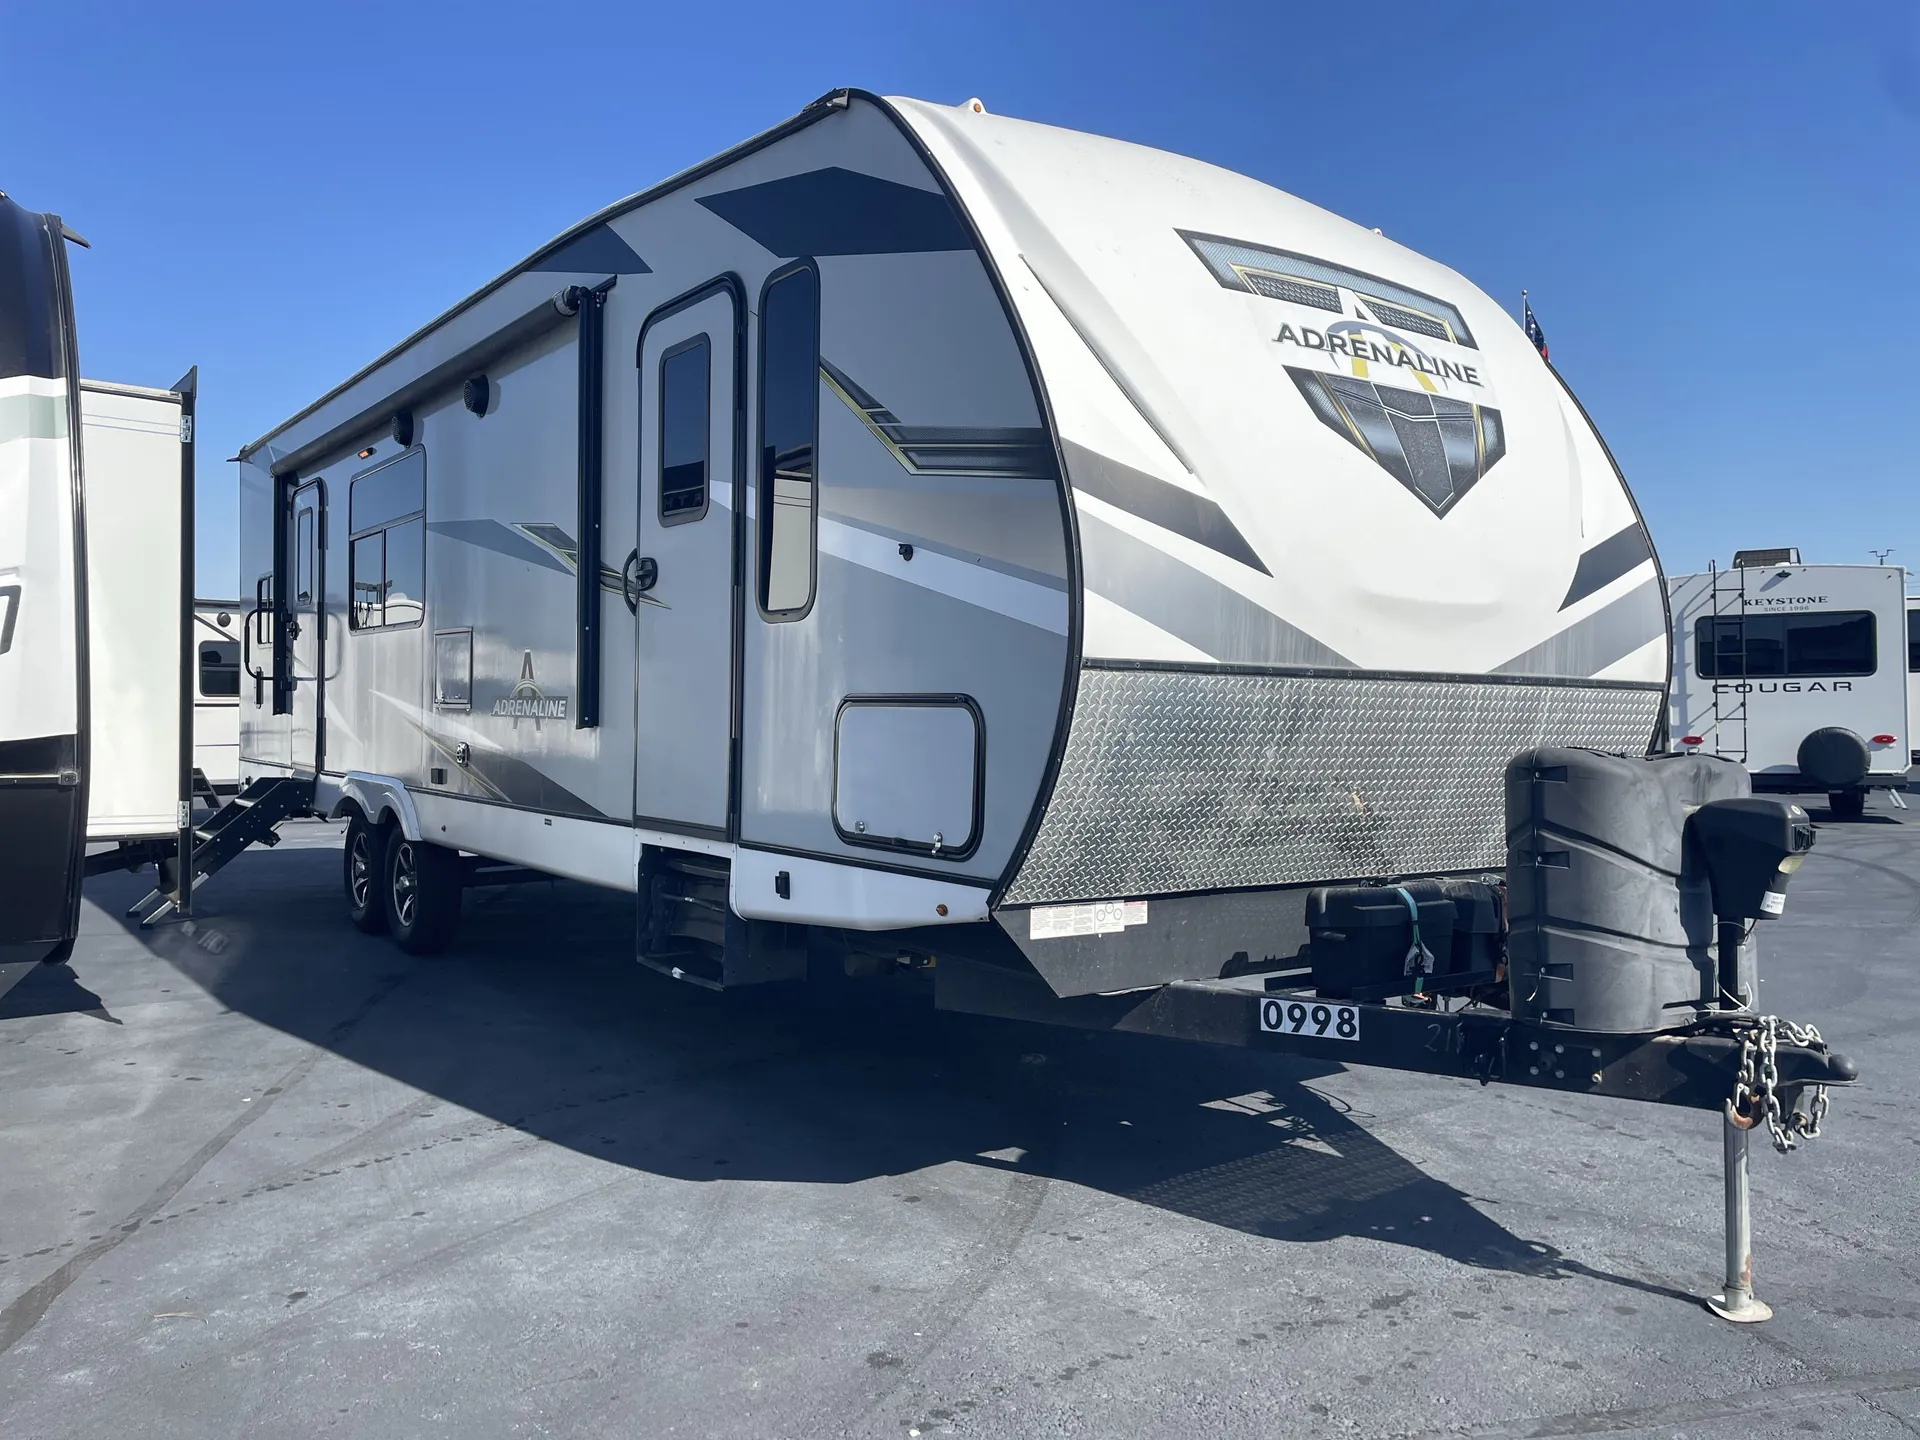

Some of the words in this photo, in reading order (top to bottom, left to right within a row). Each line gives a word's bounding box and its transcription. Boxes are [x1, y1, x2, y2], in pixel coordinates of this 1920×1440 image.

[1272, 322, 1485, 388] ADRENALINE
[1744, 595, 1829, 606] KEYSTONE
[1711, 681, 1853, 694] COUGAR
[491, 699, 567, 718] ADRENALINE
[1262, 1000, 1358, 1039] 0998
